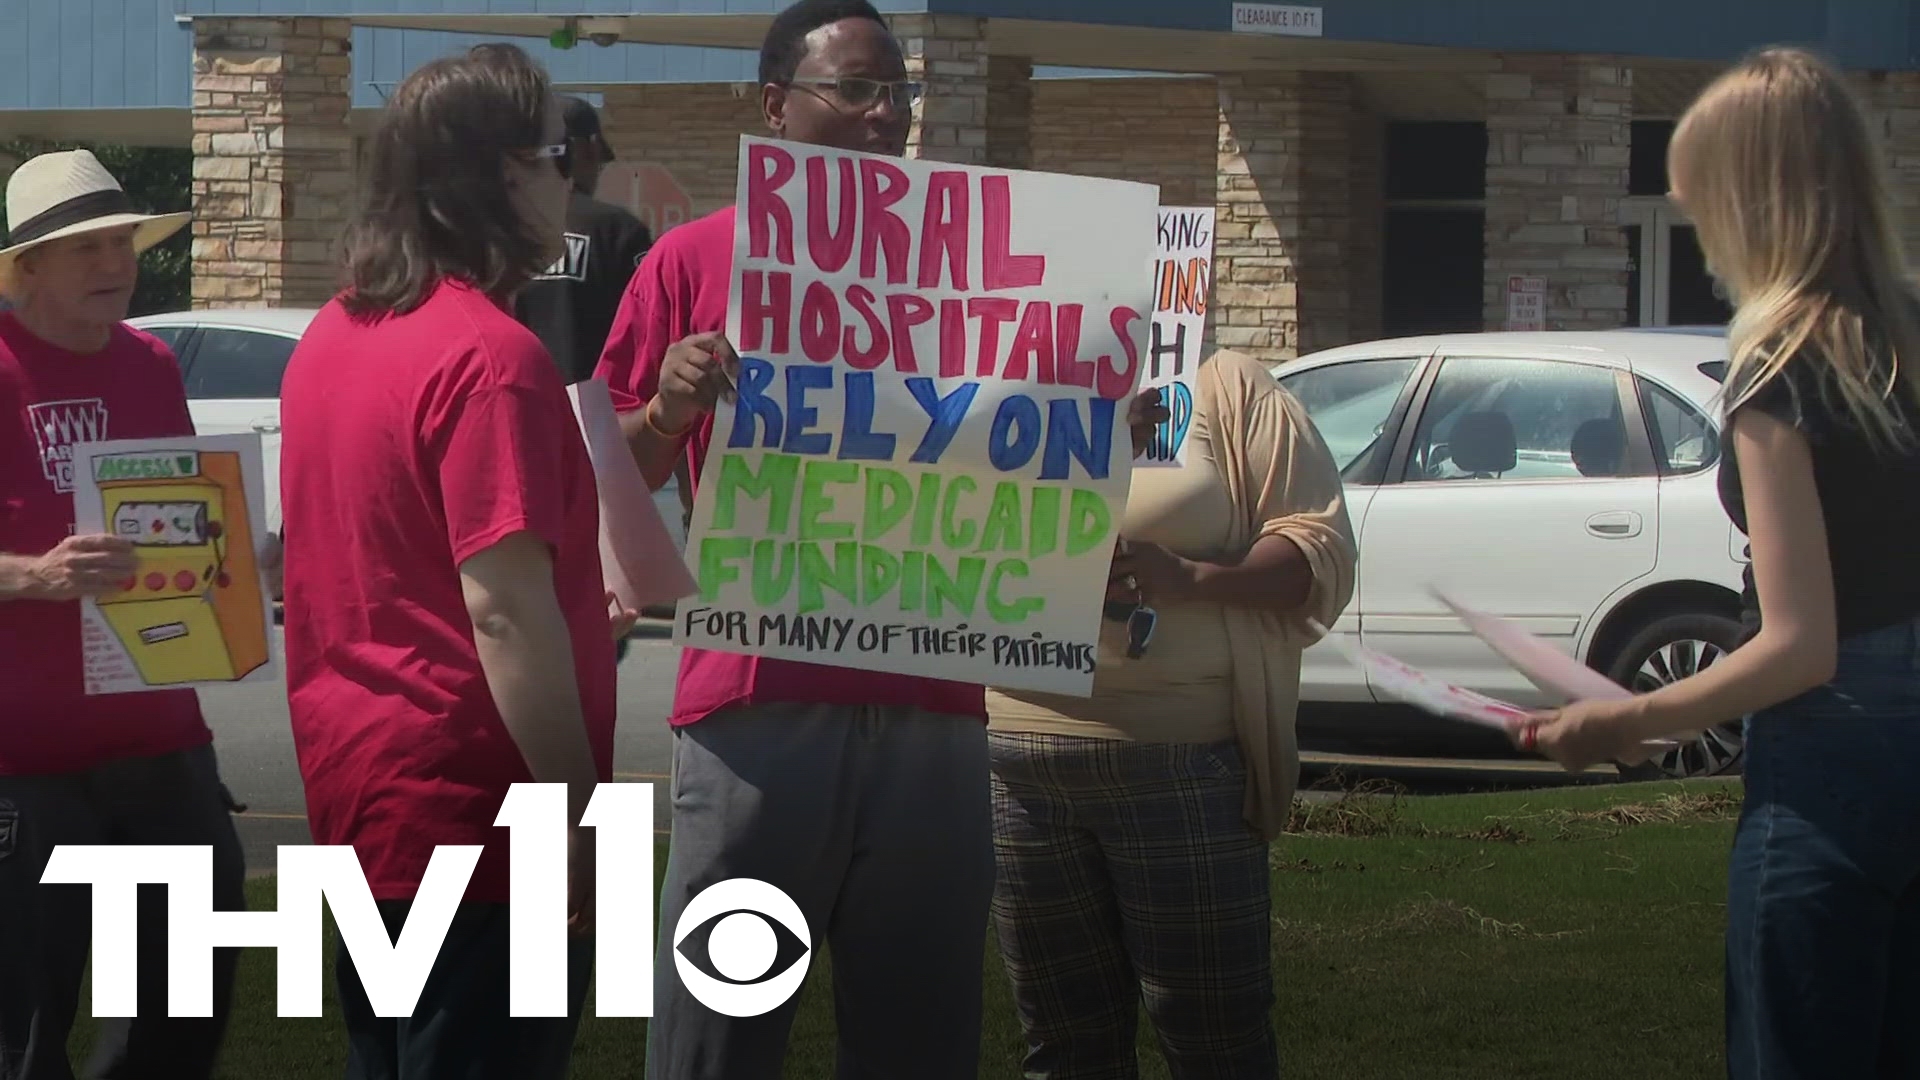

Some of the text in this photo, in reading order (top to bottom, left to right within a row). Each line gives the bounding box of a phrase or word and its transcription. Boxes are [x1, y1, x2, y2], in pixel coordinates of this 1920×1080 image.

[1236, 8, 1288, 26] CLEARANCE
[747, 143, 1046, 291] RURAL
[1152, 257, 1208, 316] INS
[739, 270, 1143, 400] HOSPITALS
[727, 357, 1116, 480] RELY ON
[97, 456, 174, 479] ACCESS
[708, 452, 1111, 560] MEDICAID
[700, 537, 1046, 624] FUNDING
[685, 606, 751, 646] FOR
[758, 613, 854, 653] MANY
[857, 622, 906, 654] OF
